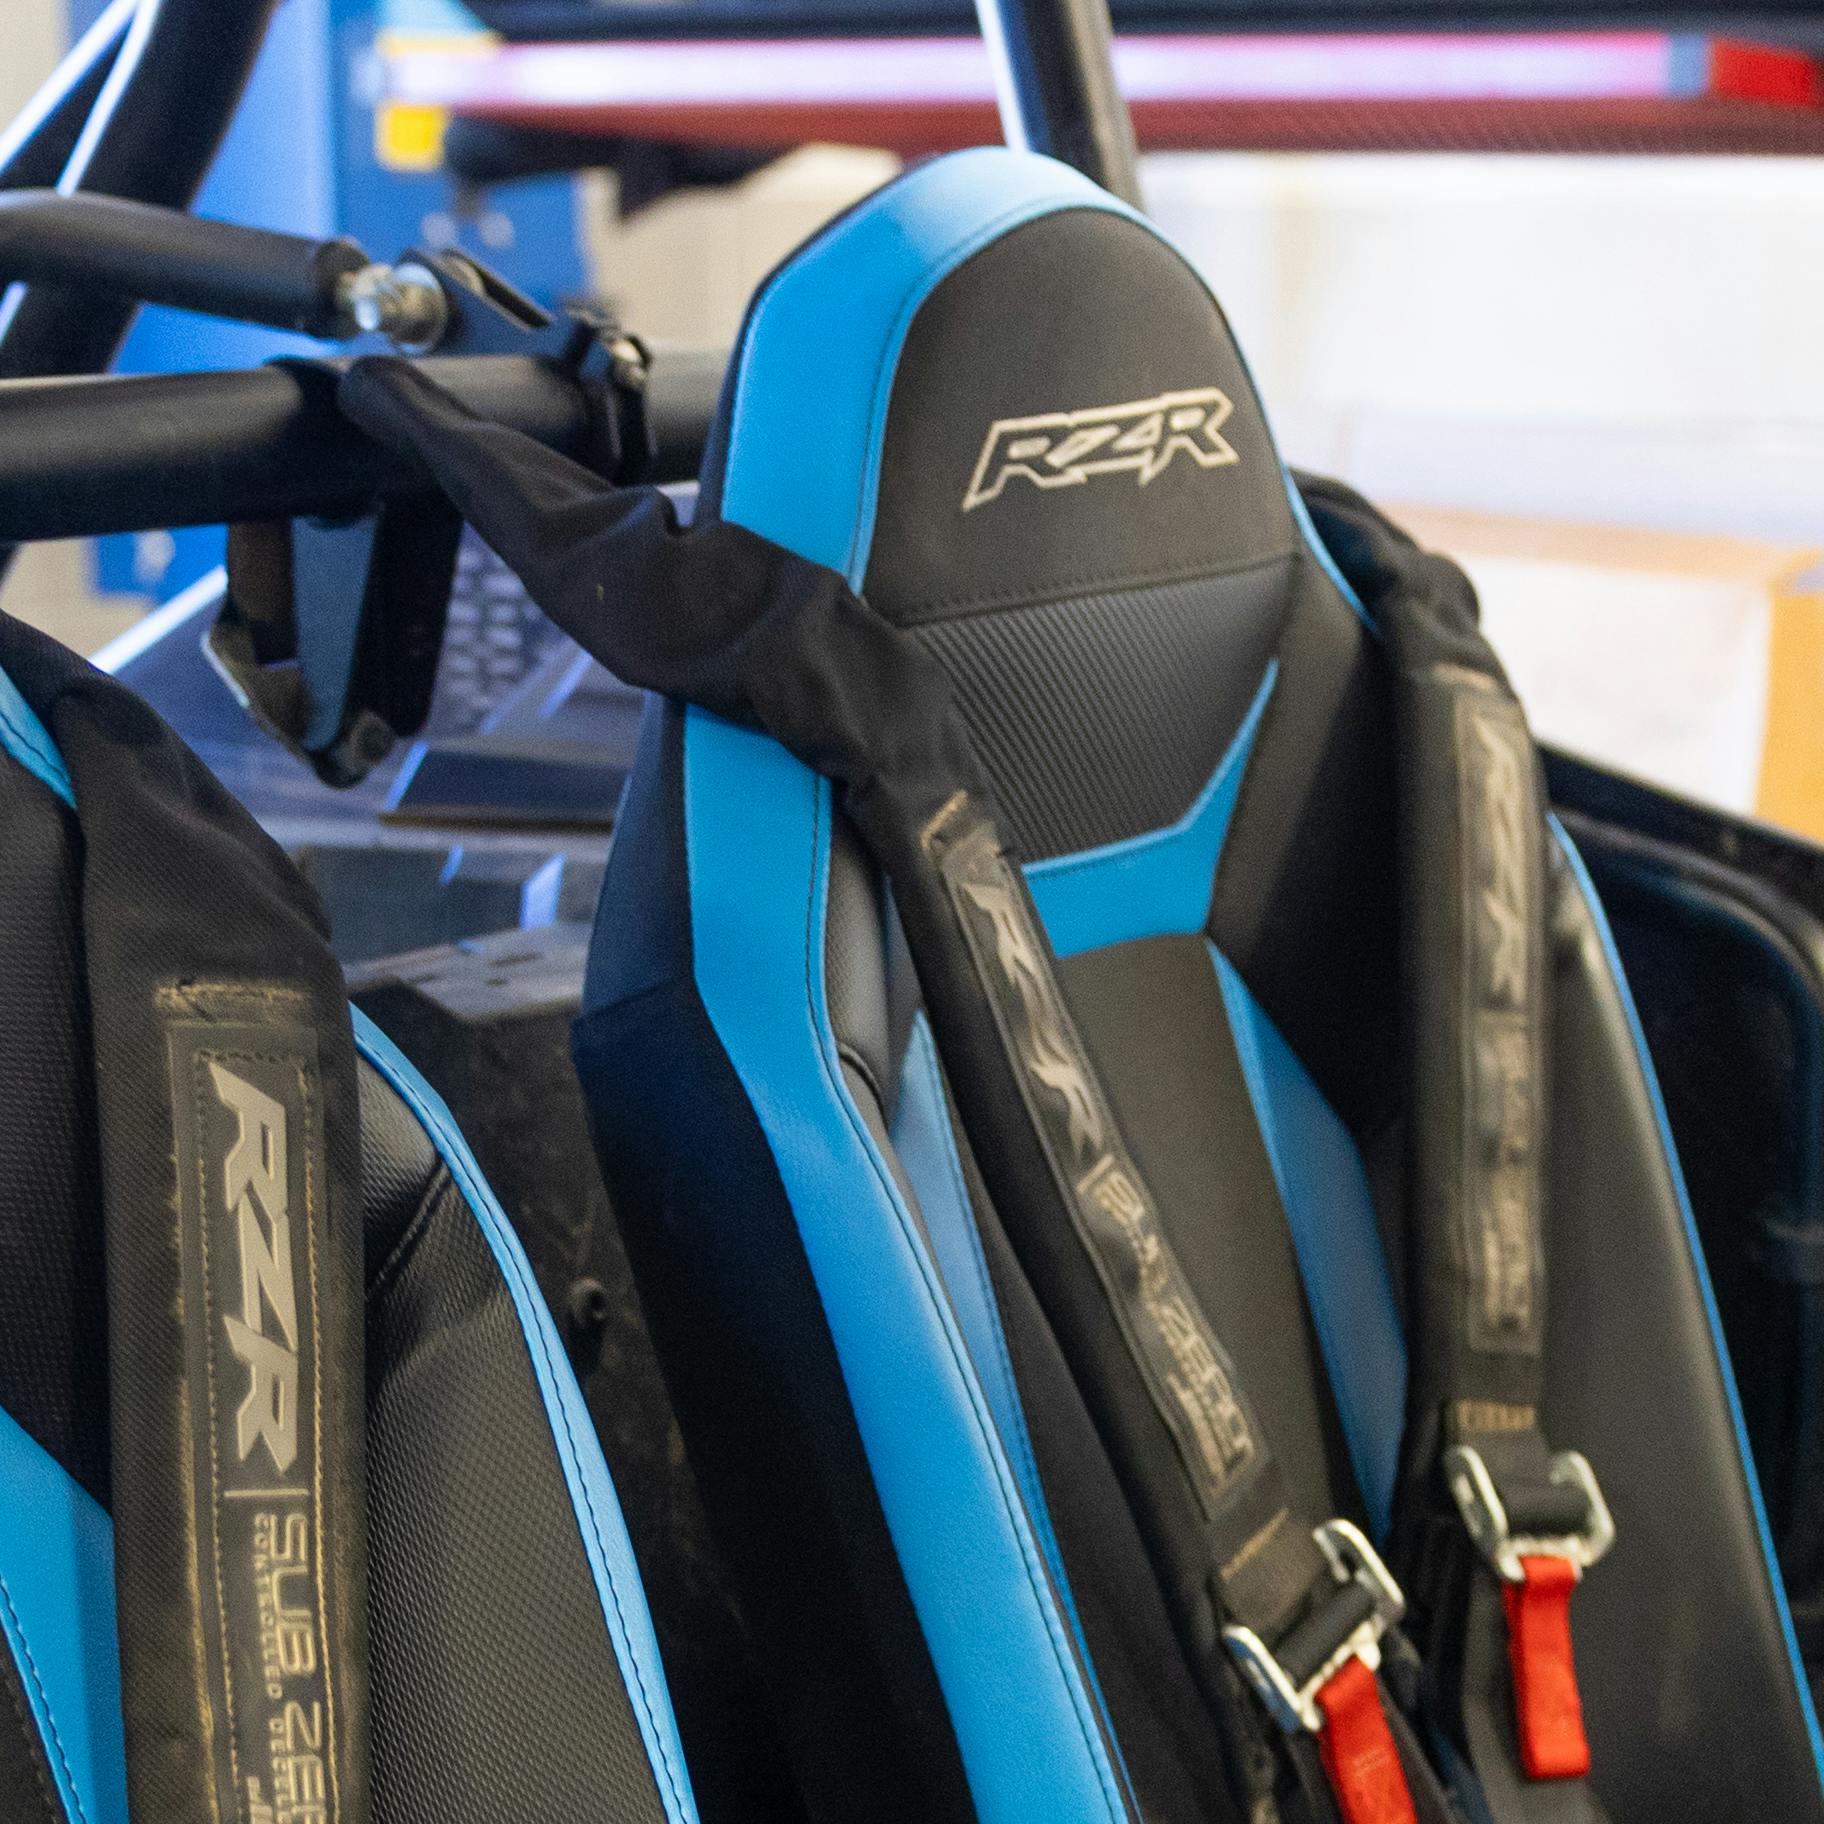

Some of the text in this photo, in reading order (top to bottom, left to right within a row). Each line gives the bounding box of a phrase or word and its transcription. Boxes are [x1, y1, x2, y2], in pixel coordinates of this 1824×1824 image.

[961, 386, 1241, 513] RZR
[208, 1060, 298, 1474] RZR
[254, 1511, 283, 1700] CONTROLLED
[270, 1512, 317, 1678] SUB
